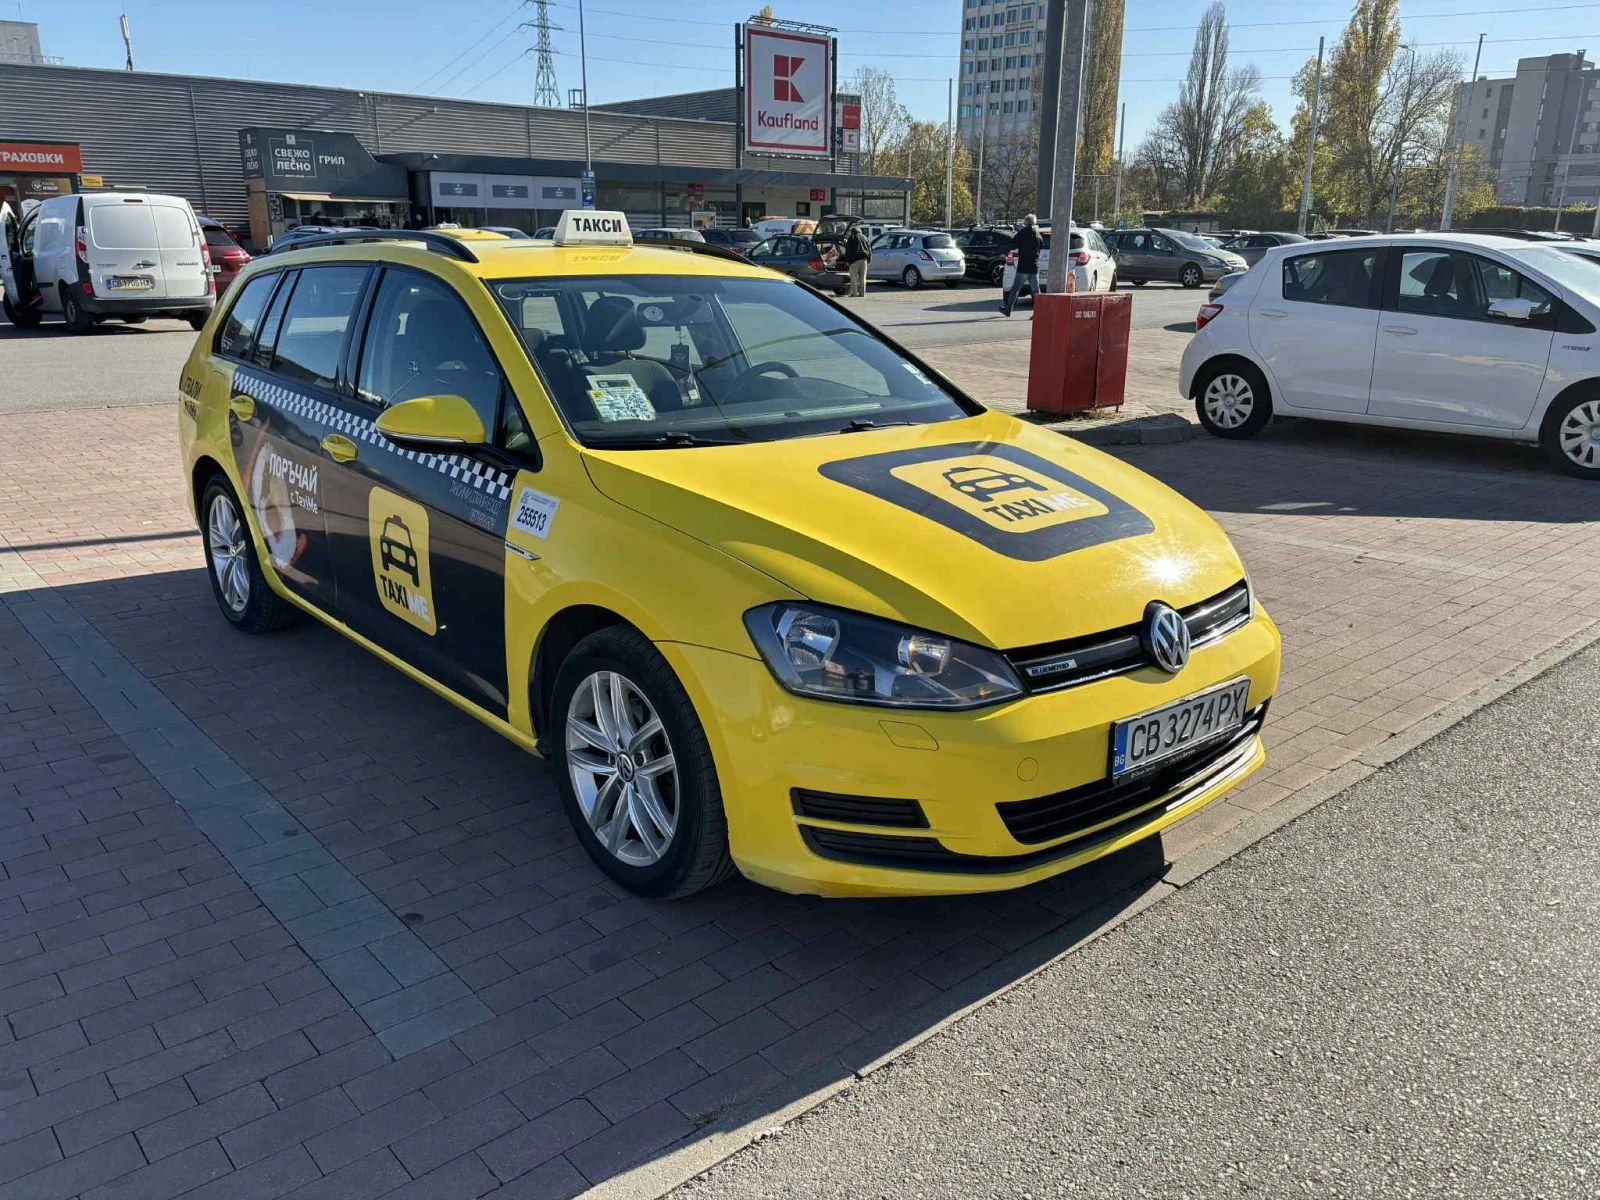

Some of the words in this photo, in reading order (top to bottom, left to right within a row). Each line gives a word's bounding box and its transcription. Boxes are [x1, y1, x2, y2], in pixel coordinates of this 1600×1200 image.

[757, 110, 819, 131] Kaufland
[0, 151, 65, 164] РАХОВКИ
[274, 148, 310, 158] СВЕЖО
[318, 155, 346, 165] ГРИЛ
[276, 161, 311, 171] ЛЕСНО
[572, 217, 622, 233] ТАКСИ
[269, 453, 318, 494] ПОРЪЧАЙ
[517, 505, 547, 531] 255513
[1114, 754, 1126, 768] BG
